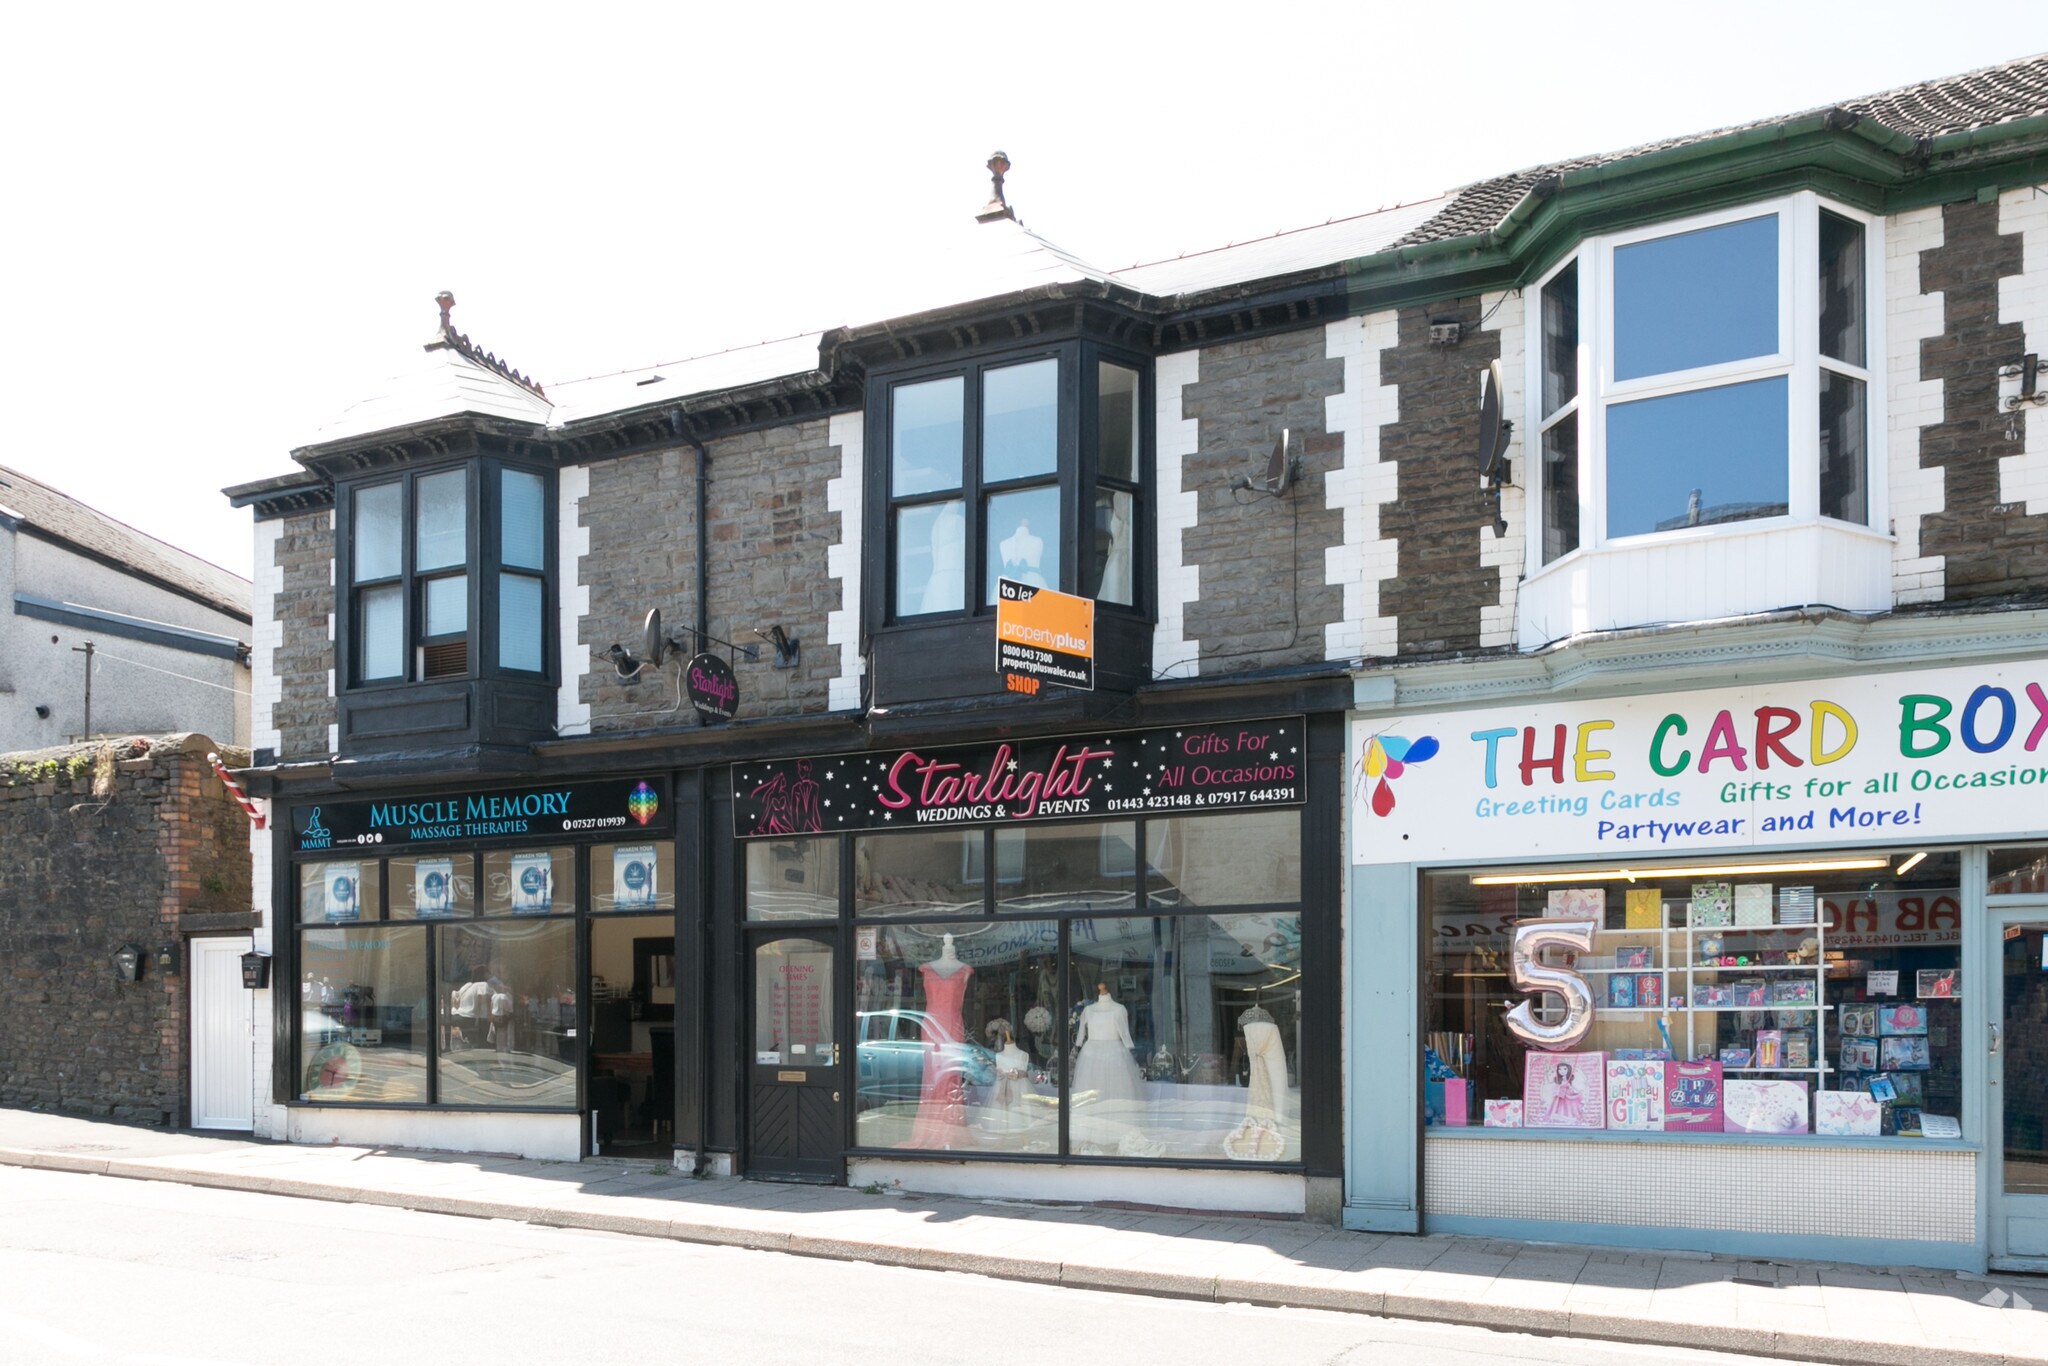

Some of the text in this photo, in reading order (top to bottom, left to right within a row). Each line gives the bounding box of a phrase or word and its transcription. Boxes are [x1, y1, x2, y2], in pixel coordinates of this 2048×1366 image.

[1001, 583, 1033, 603] to let
[1002, 622, 1086, 651] propertyplus
[1002, 644, 1053, 663] 0800 043 7300
[1002, 657, 1086, 680] propertypluswales.co.uk
[691, 667, 735, 707] Starlight
[1006, 673, 1040, 695] SHOP
[1183, 731, 1270, 755] Gifts For
[1470, 719, 1616, 789] THE
[1649, 699, 1858, 777] CARD
[877, 743, 1115, 819] Starlight
[1158, 762, 1295, 788] All Occasions
[1107, 787, 1295, 810] 01443 423148 & 07917 644391
[1720, 781, 1791, 803] Gifts
[1804, 778, 1852, 798] for
[1863, 772, 1899, 794] all
[369, 791, 572, 828] MUSCLE MEMORY
[916, 799, 1090, 822] WEDDINGS & EVENTS
[1475, 788, 1681, 818] Greeting Cards
[410, 819, 528, 839] MASSAGE THERAPIES
[572, 816, 626, 829] 07527 019939
[1597, 802, 1922, 844] Partywear and More!
[301, 837, 331, 849] MMMT
[779, 965, 814, 973] OPENING
[785, 973, 808, 981] TIMES
